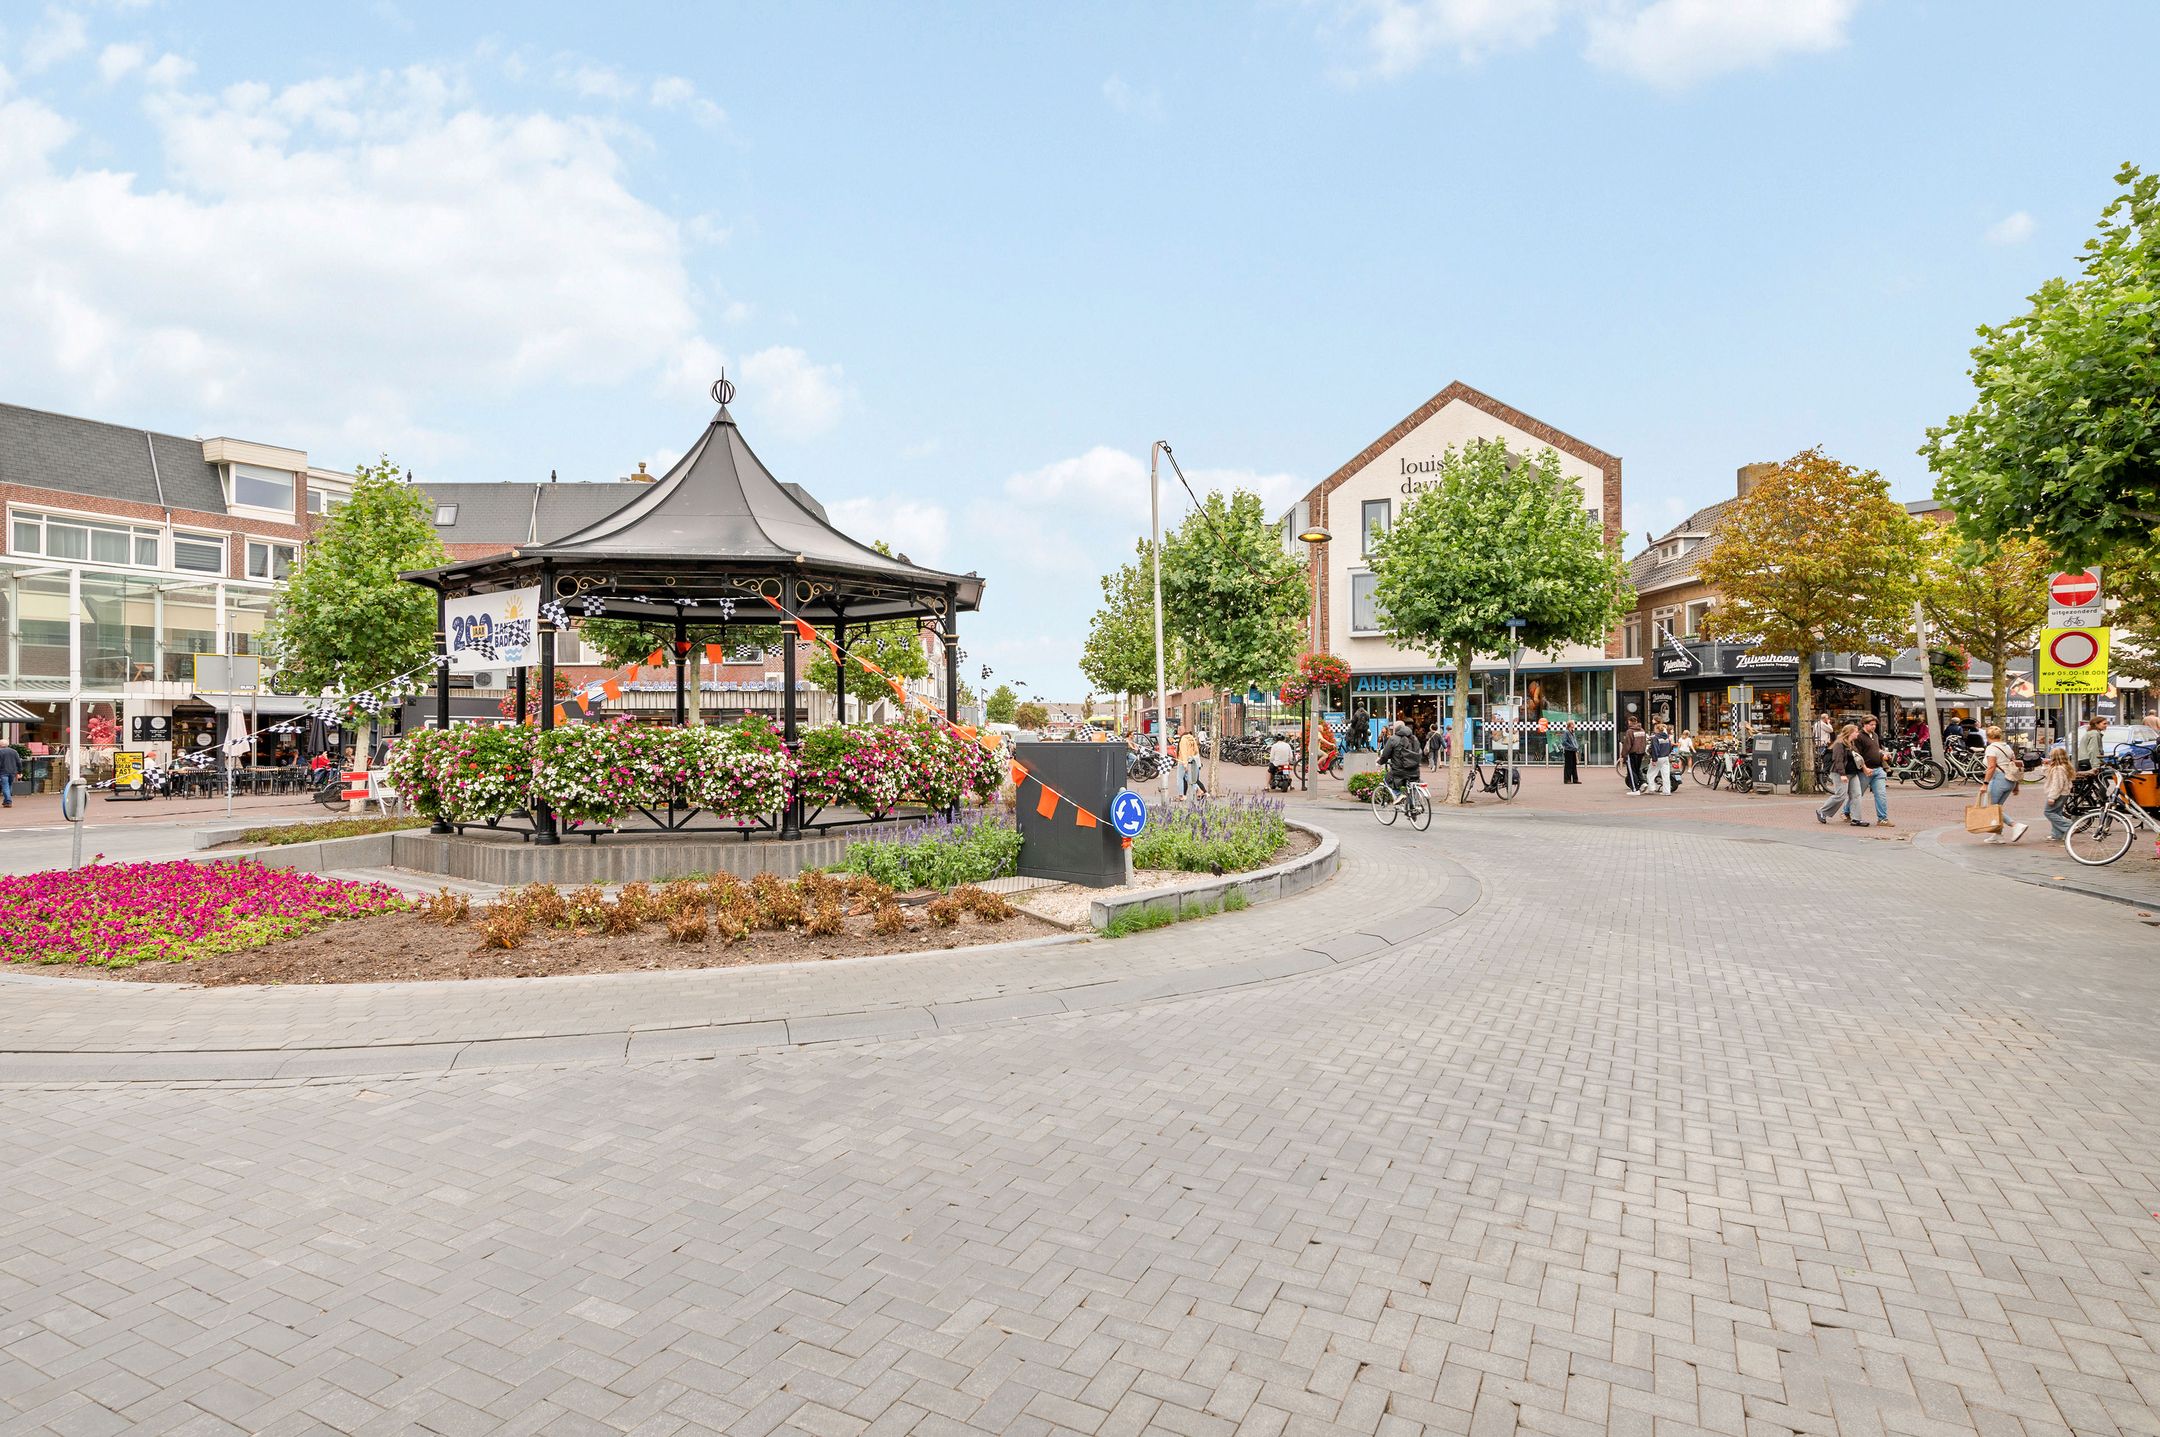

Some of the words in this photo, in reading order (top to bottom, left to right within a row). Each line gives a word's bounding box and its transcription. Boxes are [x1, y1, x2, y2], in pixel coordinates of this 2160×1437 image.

[1401, 455, 1444, 474] louis
[452, 613, 493, 651] 200
[1357, 675, 1416, 692] Albert
